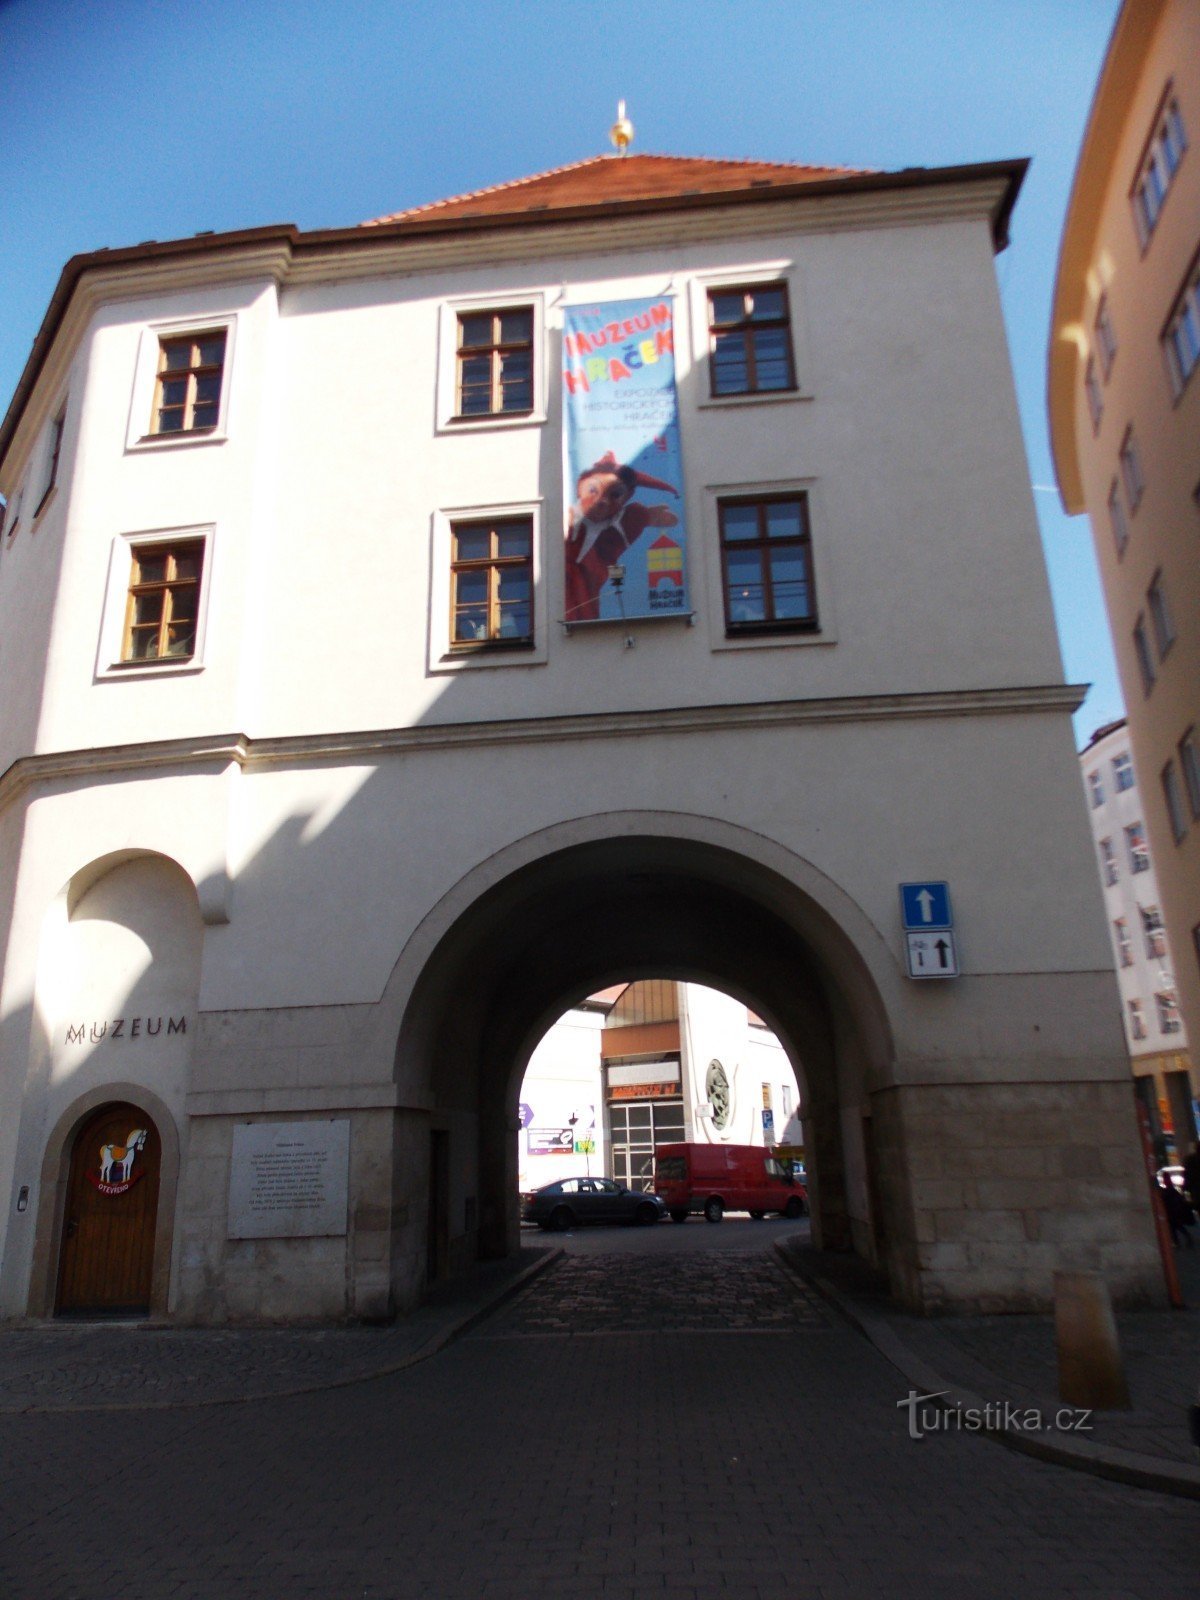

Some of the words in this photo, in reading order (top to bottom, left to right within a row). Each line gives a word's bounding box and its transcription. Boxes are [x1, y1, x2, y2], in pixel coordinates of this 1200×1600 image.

[565, 303, 671, 357] MUZEUM
[564, 329, 673, 395] HRAČEK
[67, 1016, 187, 1039] MUZEUM
[763, 1111, 772, 1124] P
